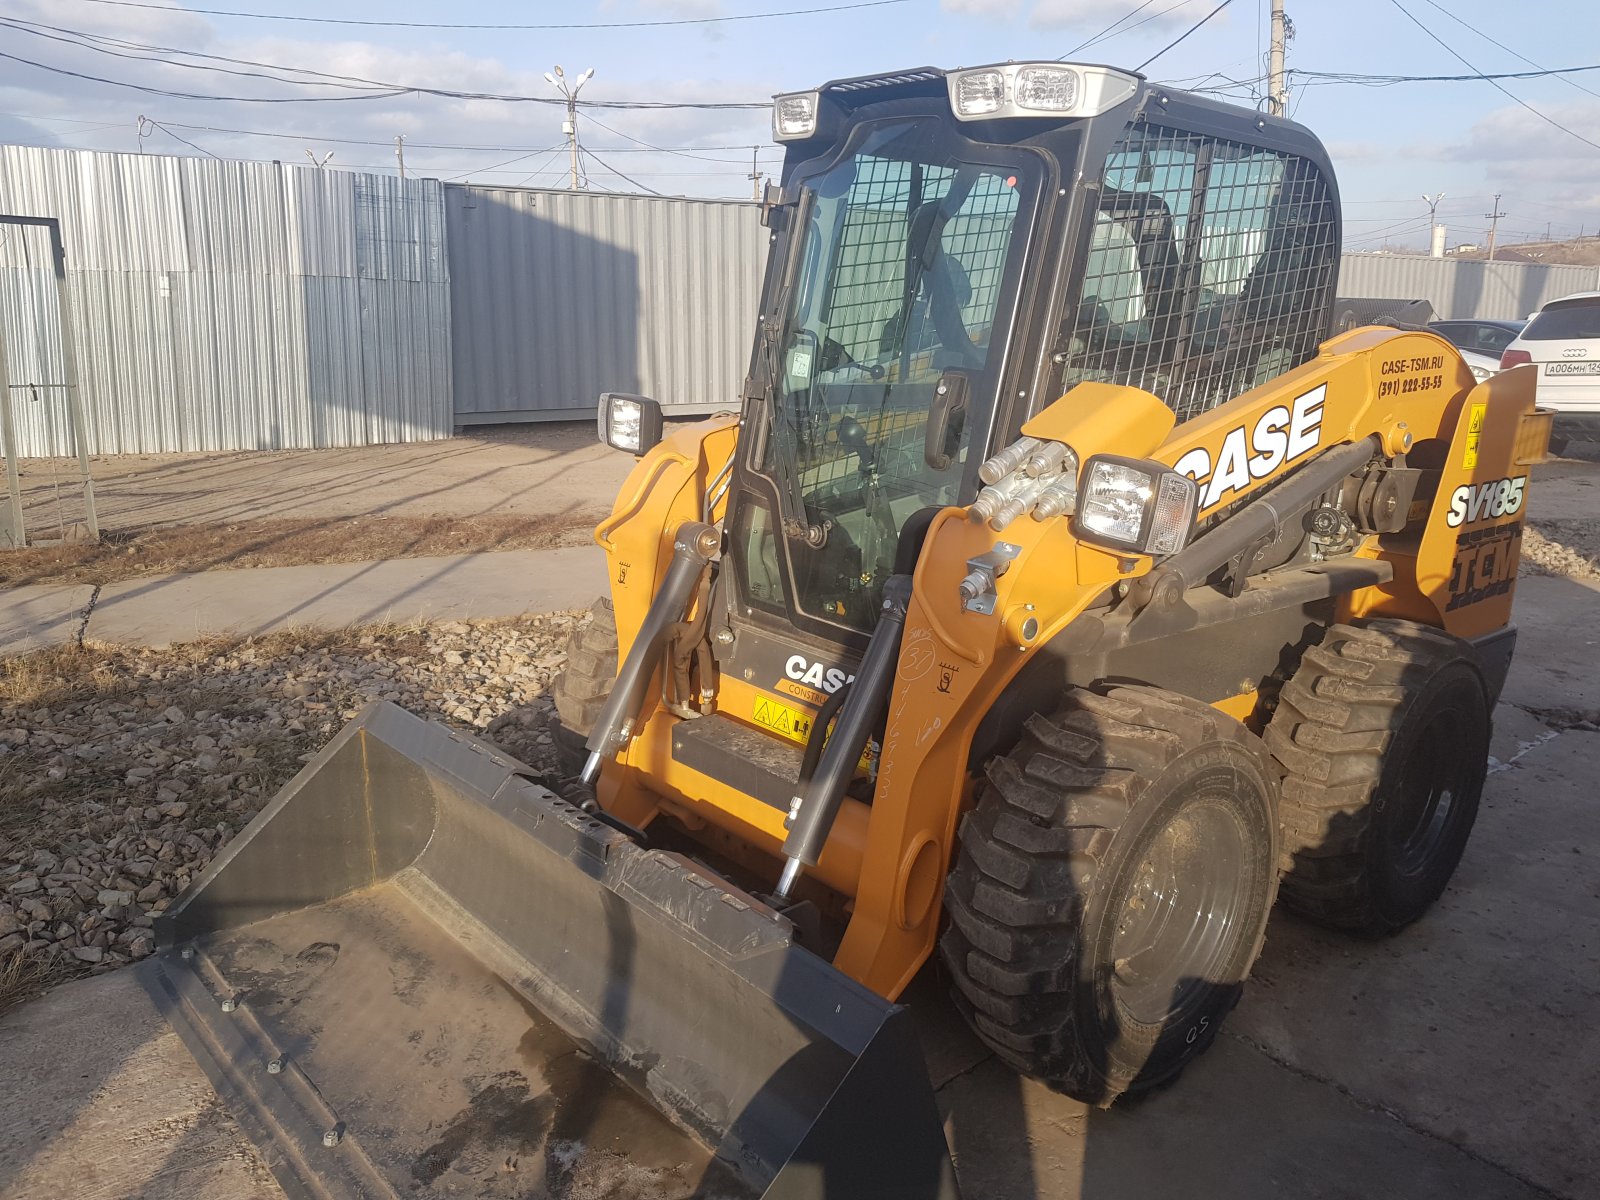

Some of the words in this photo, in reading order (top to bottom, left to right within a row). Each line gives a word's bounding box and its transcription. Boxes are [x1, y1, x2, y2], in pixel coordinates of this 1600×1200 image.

[1381, 356, 1444, 375] CASE-TSM.RU
[1378, 377, 1400, 400] (391)
[1401, 375, 1443, 393] 222-55-55
[1173, 381, 1328, 513] CASE
[1447, 475, 1527, 528] SV185
[1452, 532, 1521, 595] TCM
[785, 655, 856, 694] CAS
[903, 647, 934, 671] 37
